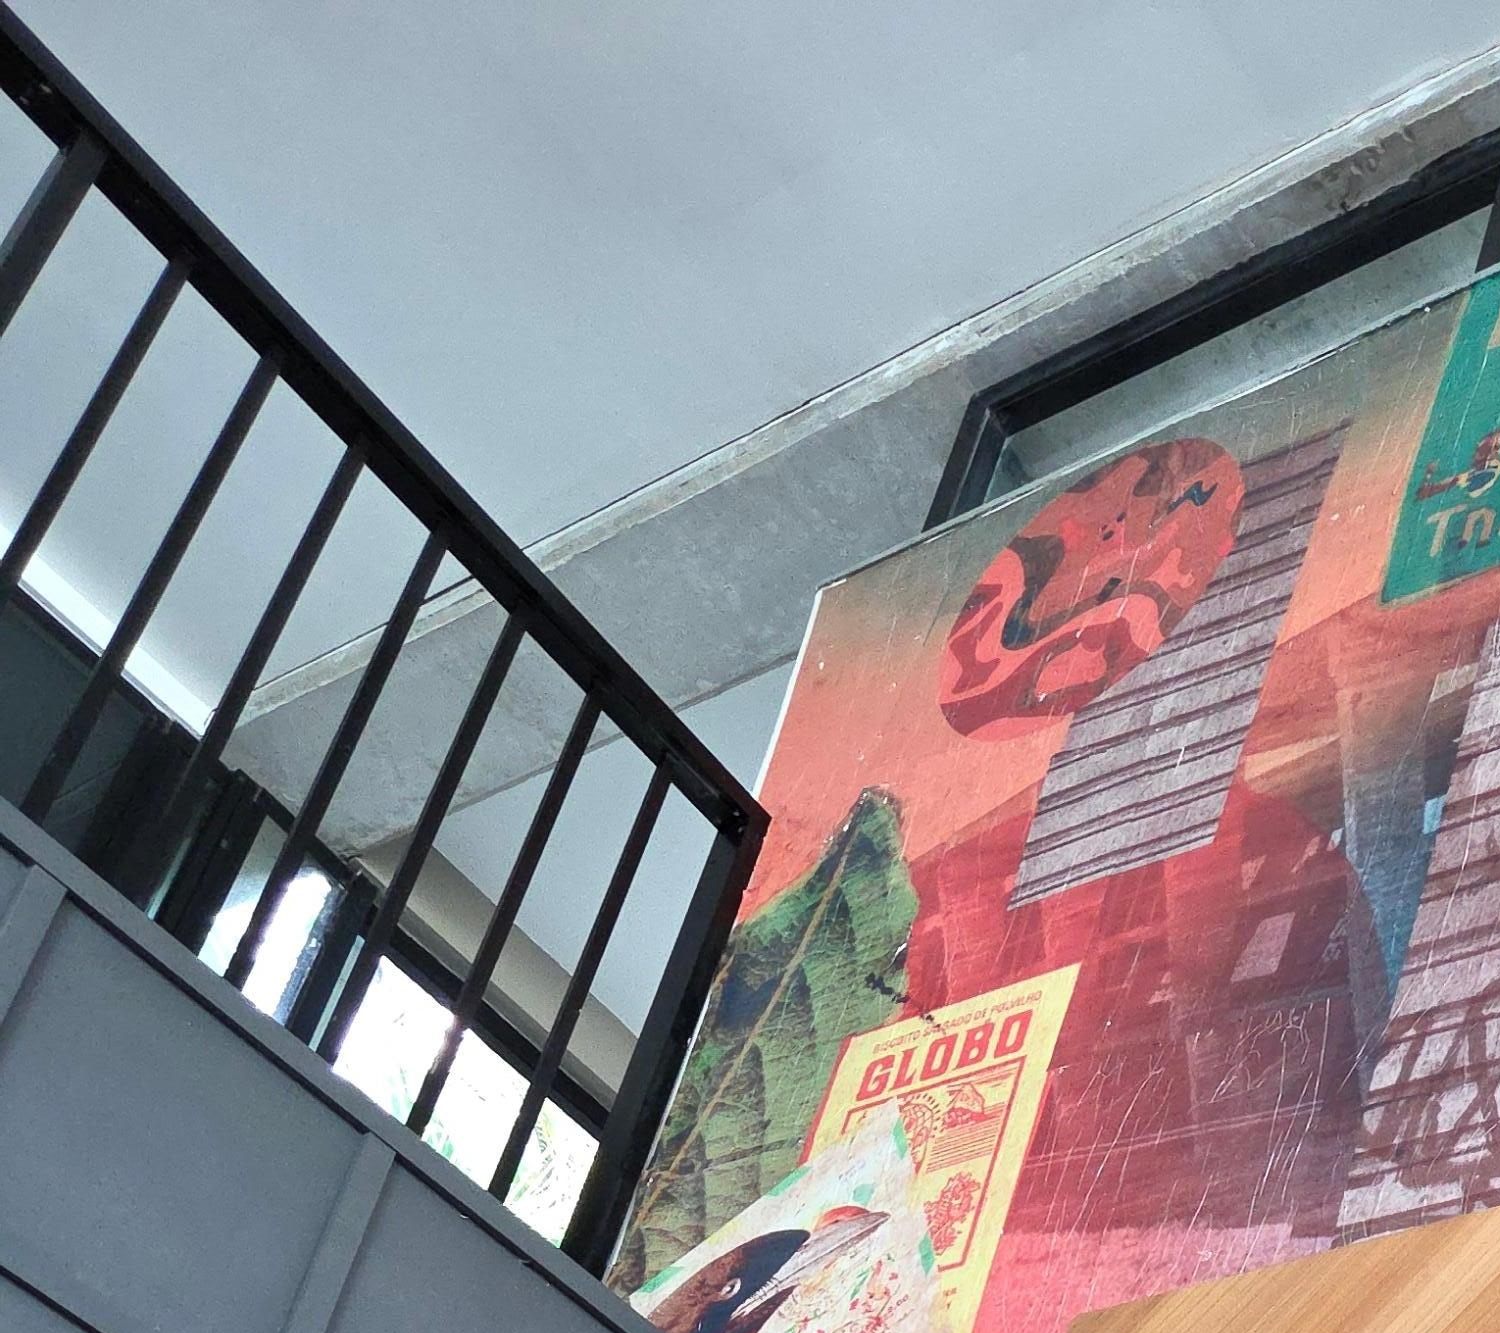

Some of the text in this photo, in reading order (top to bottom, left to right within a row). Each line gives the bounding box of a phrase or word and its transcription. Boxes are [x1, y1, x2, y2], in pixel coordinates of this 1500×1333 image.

[856, 1009, 1034, 1101] GLOBO
[873, 1028, 922, 1054] BISCOITO
[973, 1009, 989, 1024] DE
